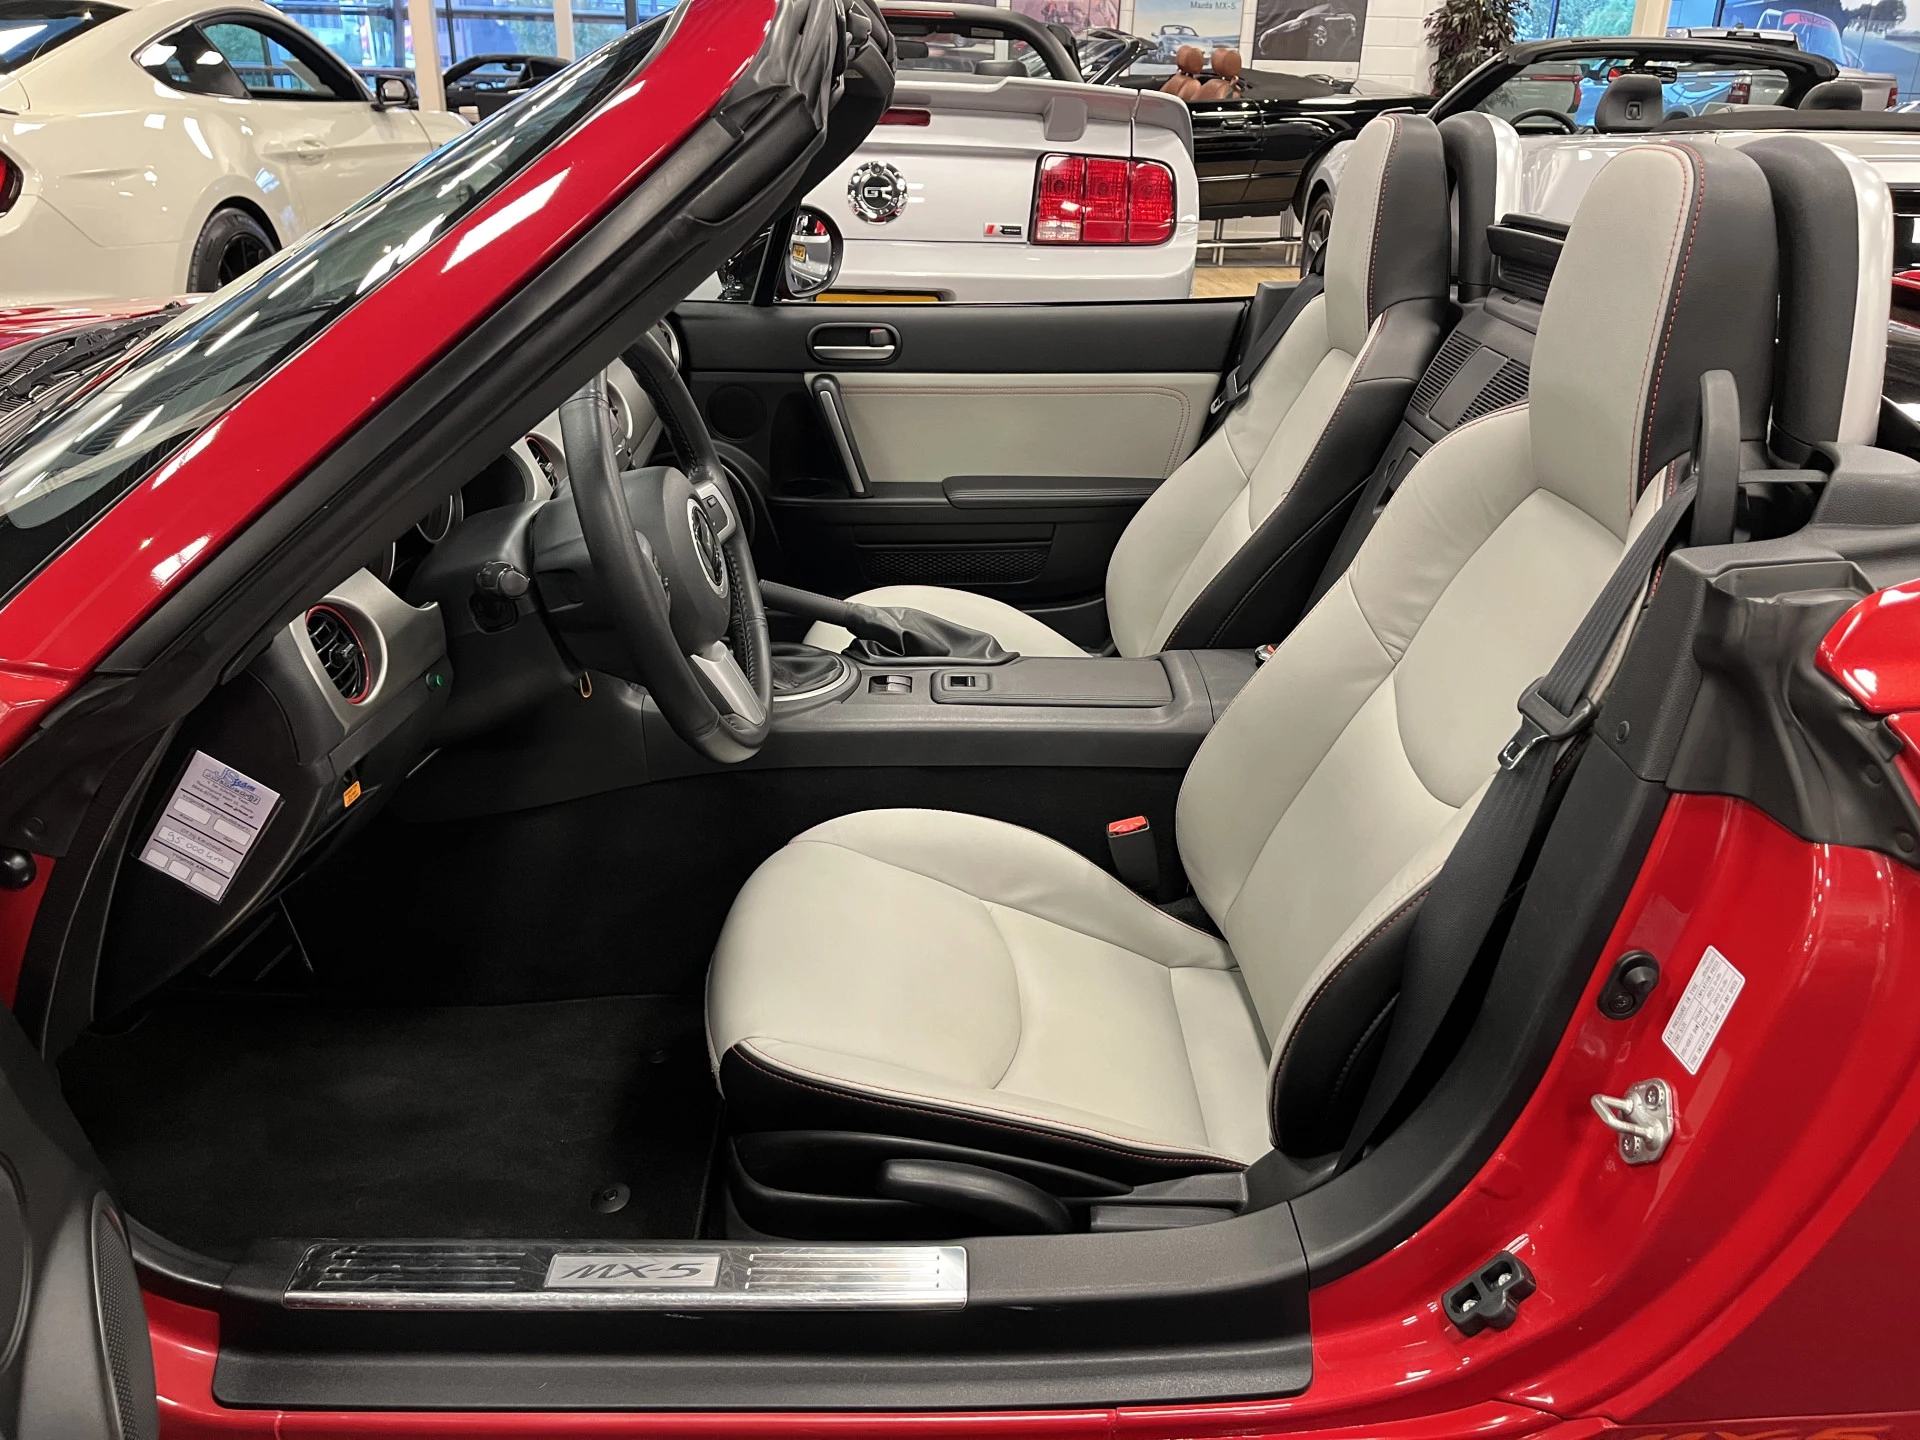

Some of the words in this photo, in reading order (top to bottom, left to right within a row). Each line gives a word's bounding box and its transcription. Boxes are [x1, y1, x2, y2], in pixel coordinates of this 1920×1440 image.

[1189, 1, 1213, 9] Mazda
[1215, 1, 1236, 10] MX-5
[1696, 974, 1711, 999] INFLATION
[1671, 1004, 1686, 1029] PRESSURE
[1696, 1030, 1710, 1054] INFLATION
[561, 1262, 704, 1280] MX-5
